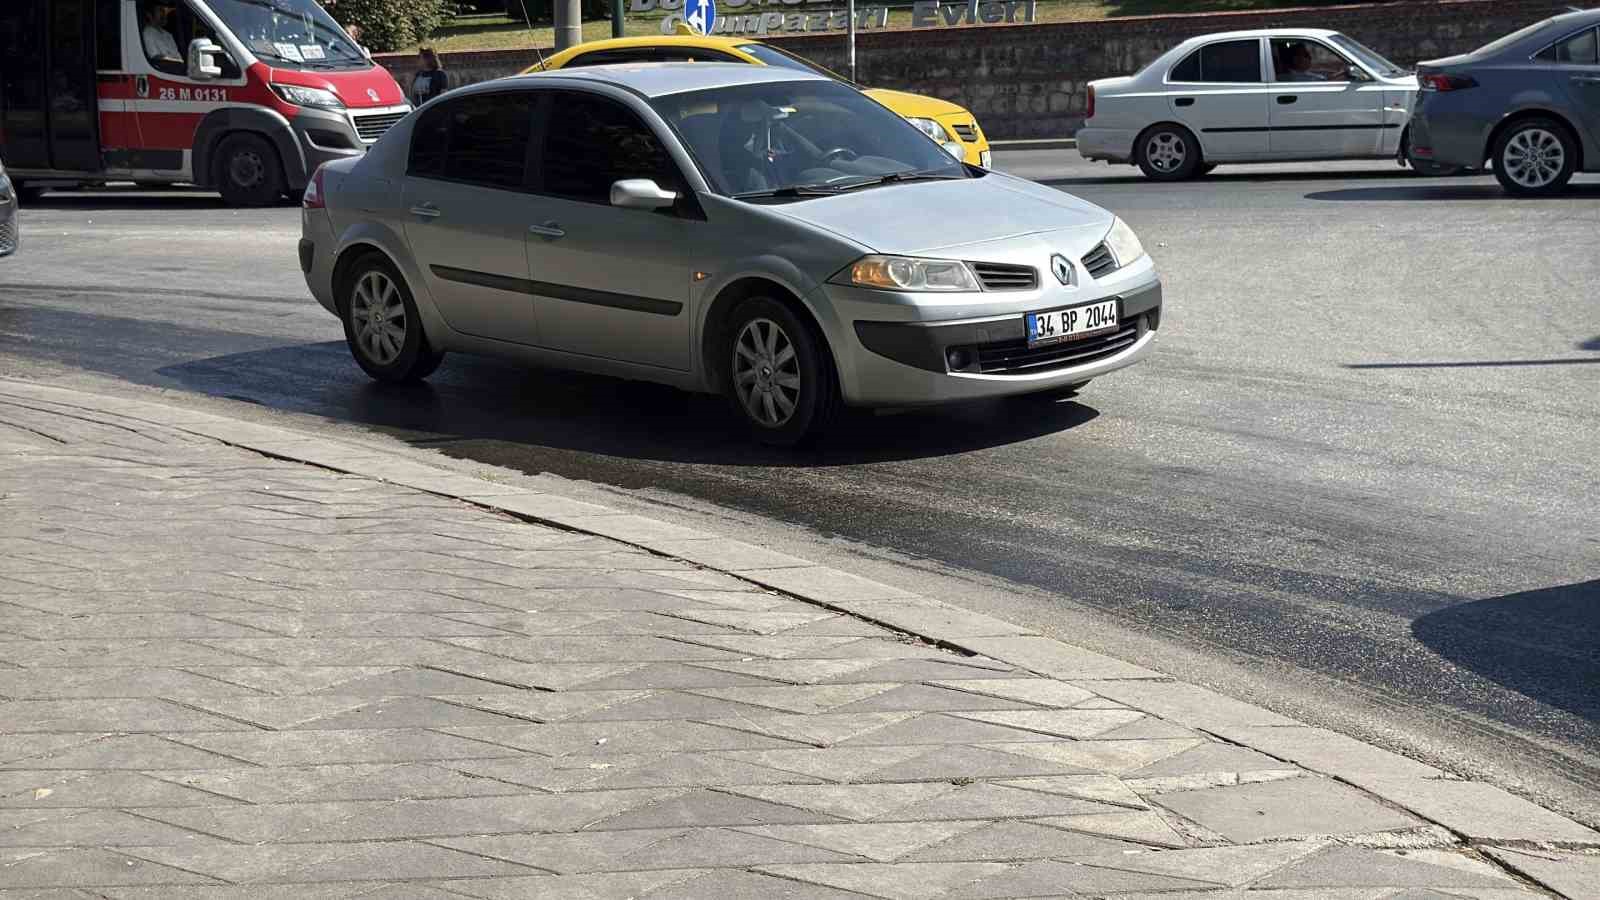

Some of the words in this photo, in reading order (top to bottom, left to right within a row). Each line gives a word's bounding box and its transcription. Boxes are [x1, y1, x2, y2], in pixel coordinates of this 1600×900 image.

[160, 87, 176, 100] 26
[179, 87, 191, 100] M
[194, 88, 227, 101] 0131
[1037, 314, 1055, 337] 34
[1061, 310, 1078, 334] BP
[1085, 303, 1116, 329] 2044
